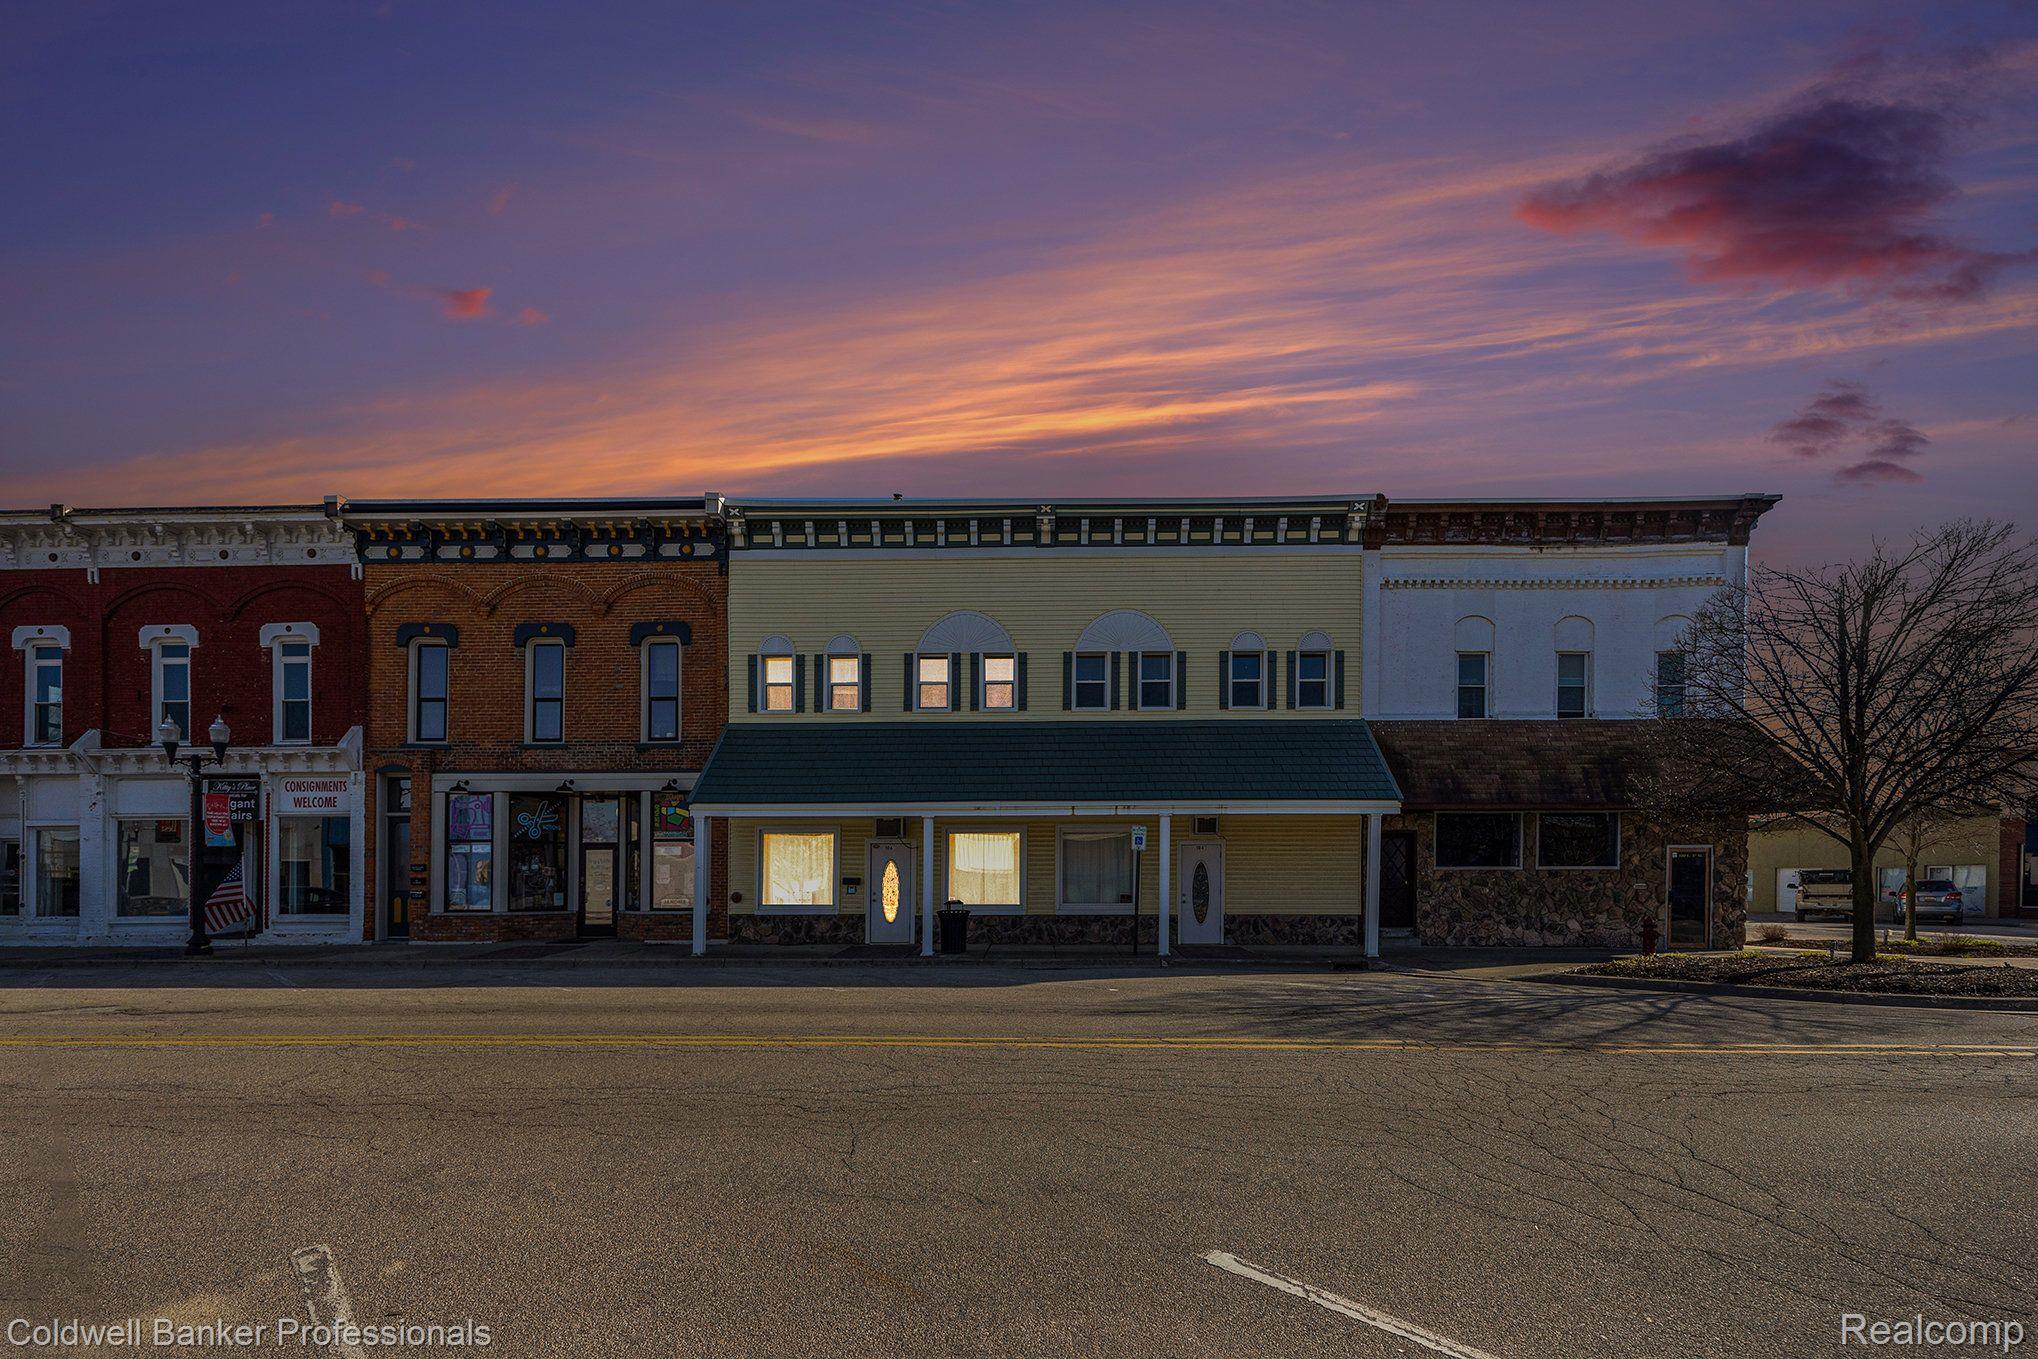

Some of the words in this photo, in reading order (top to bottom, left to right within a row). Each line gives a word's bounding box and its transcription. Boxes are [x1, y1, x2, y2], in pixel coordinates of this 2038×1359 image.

[284, 781, 347, 792] CONSIGNMENTS
[230, 799, 256, 811] gant
[293, 796, 338, 808] WELCOME
[230, 810, 253, 820] airs
